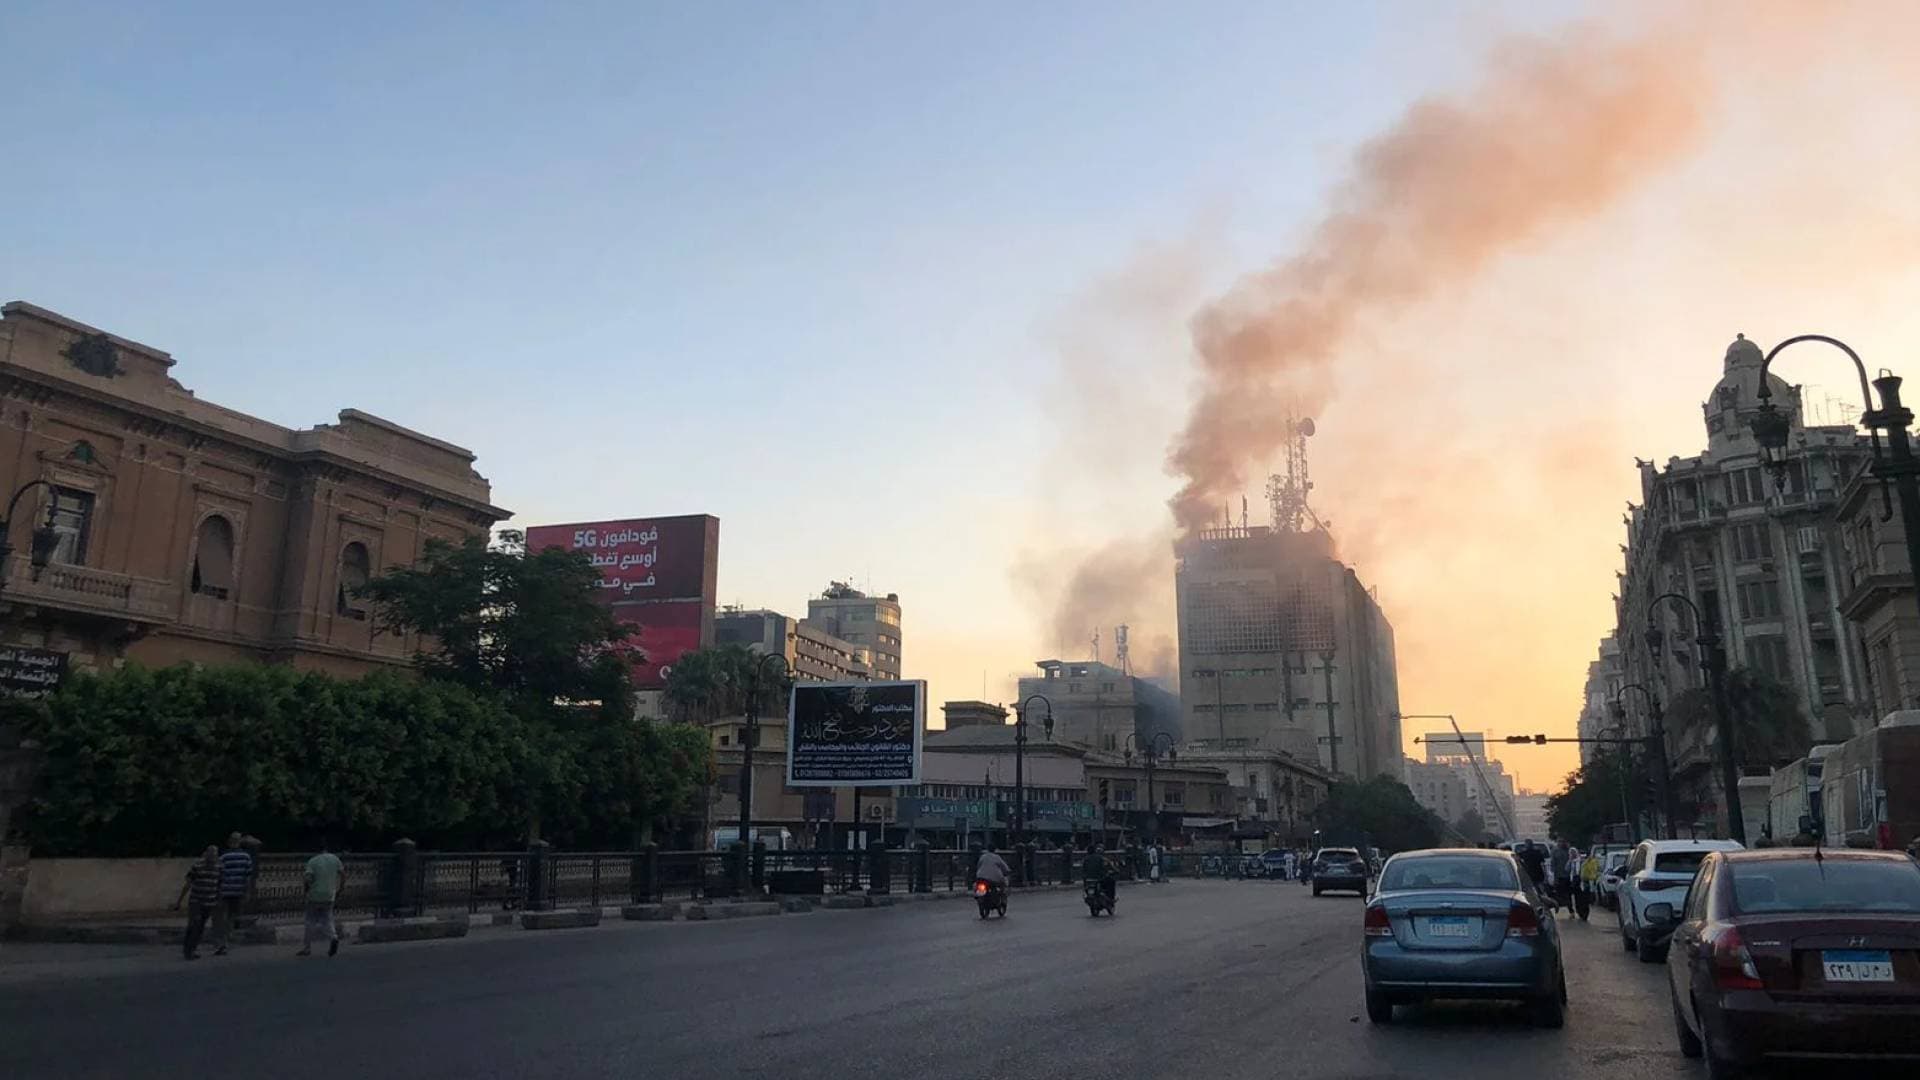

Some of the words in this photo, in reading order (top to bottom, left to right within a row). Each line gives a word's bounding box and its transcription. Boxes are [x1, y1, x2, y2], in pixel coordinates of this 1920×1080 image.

[573, 530, 597, 547] 5G
[593, 578, 621, 588] مص
[623, 571, 656, 594] في
